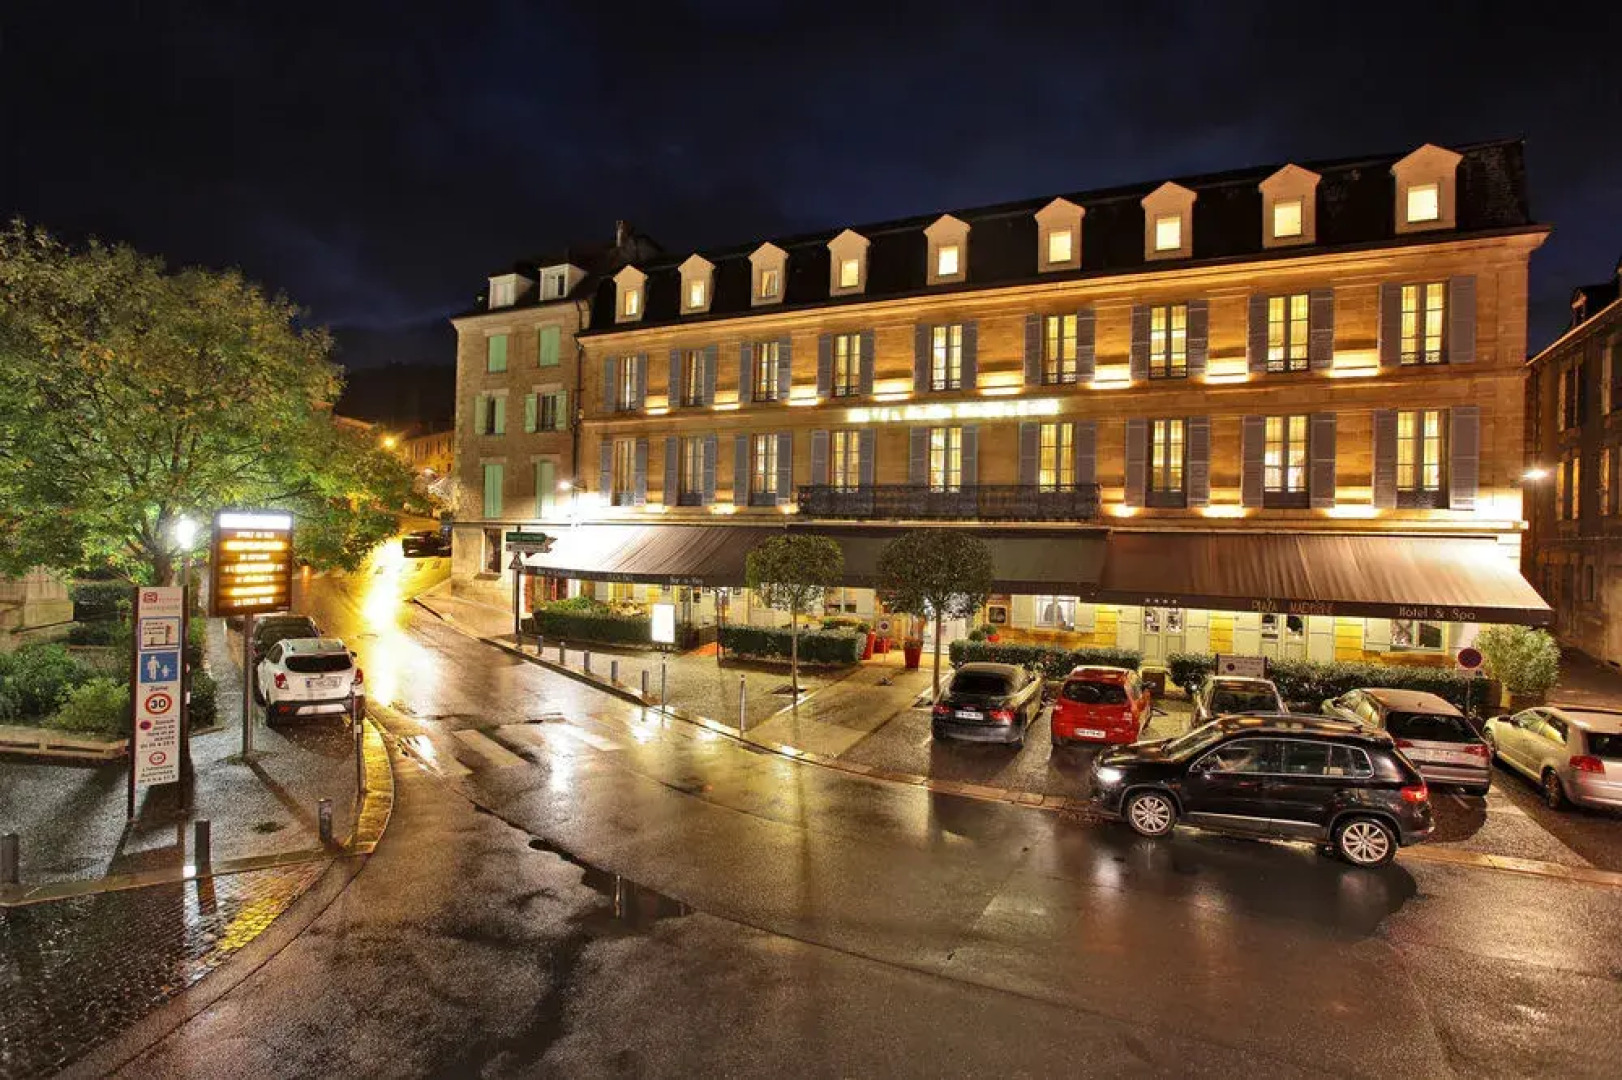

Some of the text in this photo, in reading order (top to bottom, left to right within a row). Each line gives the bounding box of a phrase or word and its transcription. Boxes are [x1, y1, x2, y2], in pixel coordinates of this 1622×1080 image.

[1399, 606, 1476, 621] Hotel & Spa
[150, 698, 166, 709] 30
